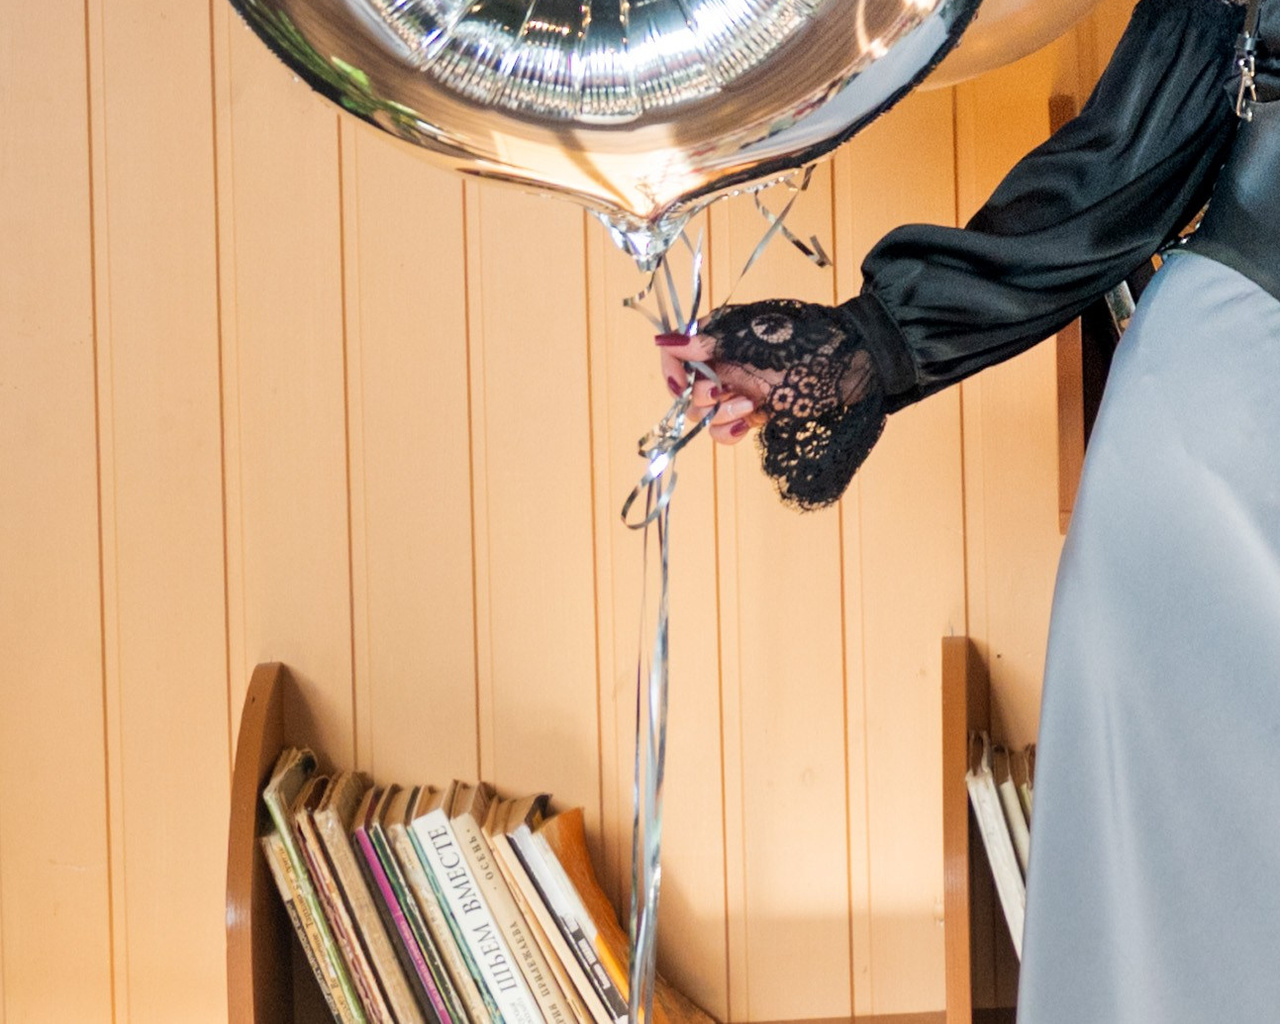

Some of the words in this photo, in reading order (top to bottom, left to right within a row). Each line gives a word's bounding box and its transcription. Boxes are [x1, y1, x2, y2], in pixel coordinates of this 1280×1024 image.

[428, 825, 481, 915] ВМЕСТЕ
[468, 834, 495, 880] ОСЕНЬ
[473, 922, 518, 994] ШЬЕМ
[509, 921, 550, 997] ПРИЛЕЖАЕВА
